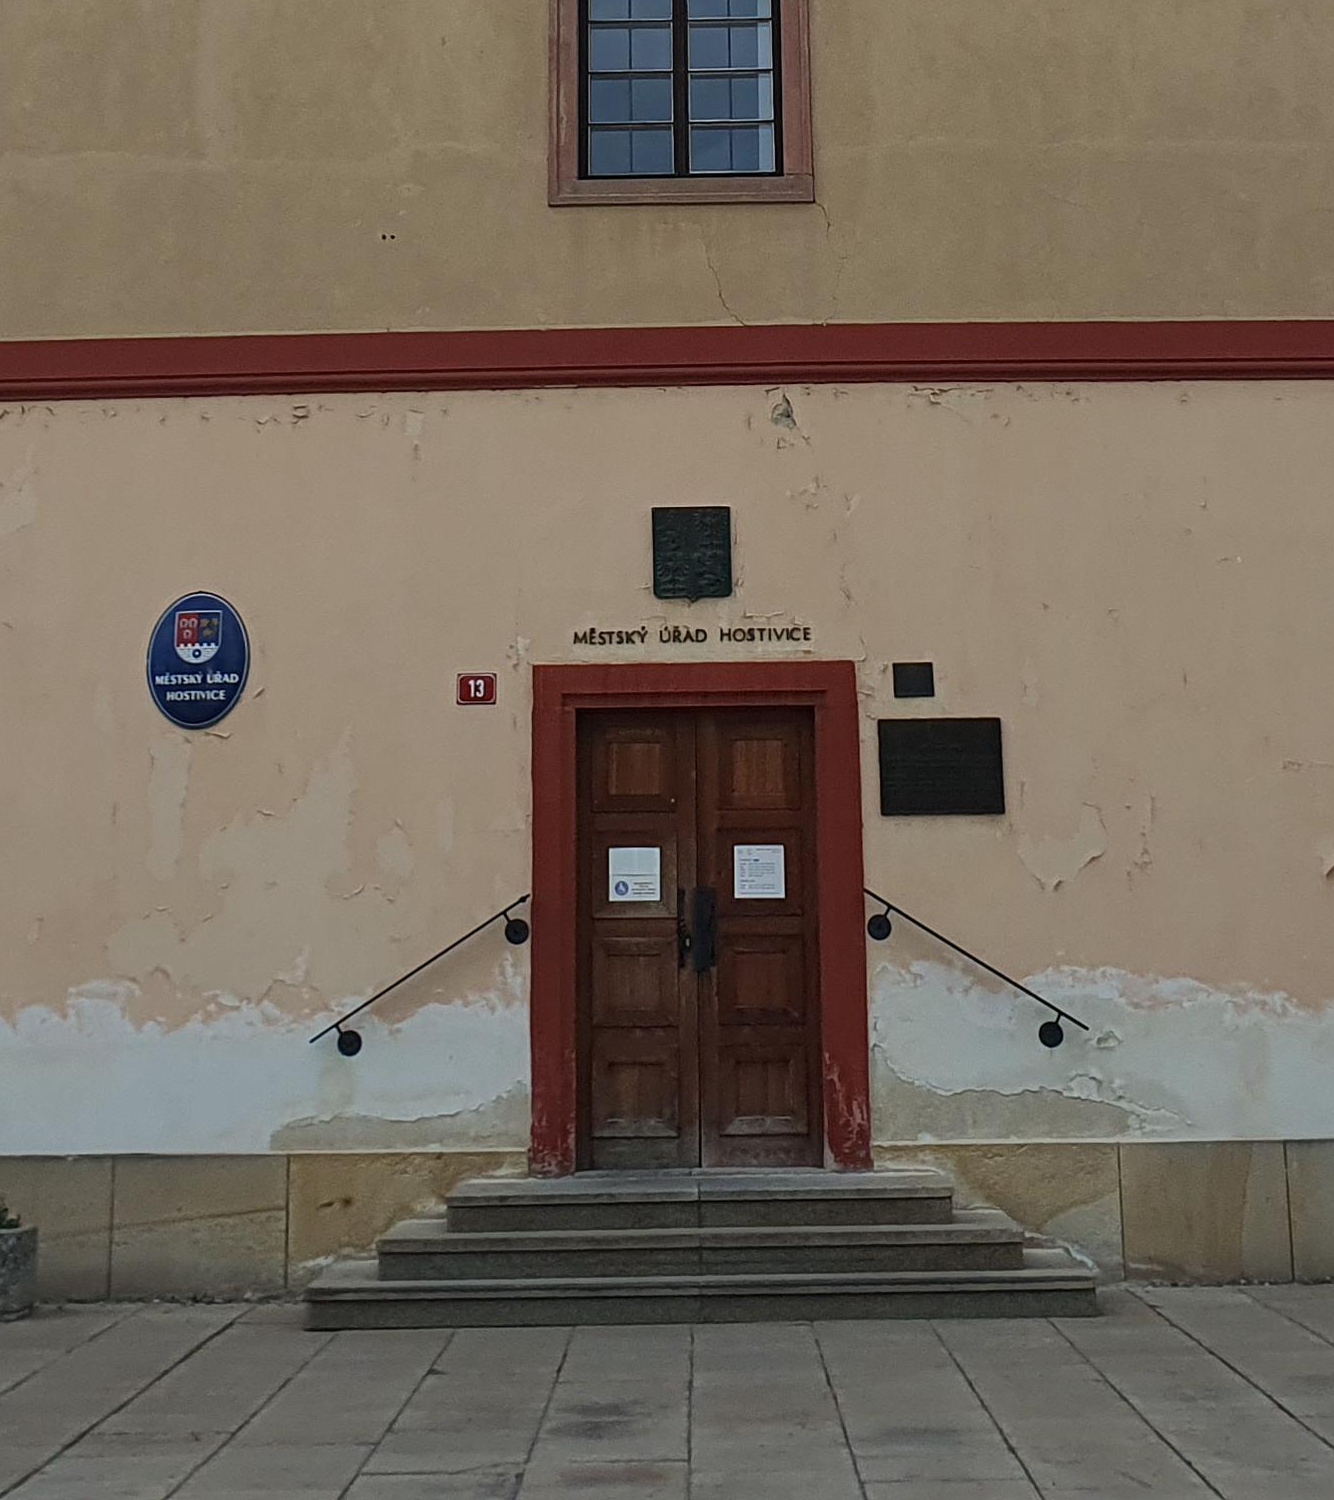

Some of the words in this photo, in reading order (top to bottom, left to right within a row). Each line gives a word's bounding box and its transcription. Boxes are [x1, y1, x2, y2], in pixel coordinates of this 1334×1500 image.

[572, 626, 648, 645] MĚSTSKÝ
[659, 626, 708, 643] ÚŘAD
[719, 627, 812, 643] HOSTIVICE
[155, 671, 203, 685] MĚSTSKÝ
[206, 670, 239, 683] ÚŘAD
[166, 690, 226, 701] HOSTIVICE
[468, 679, 484, 698] 13
